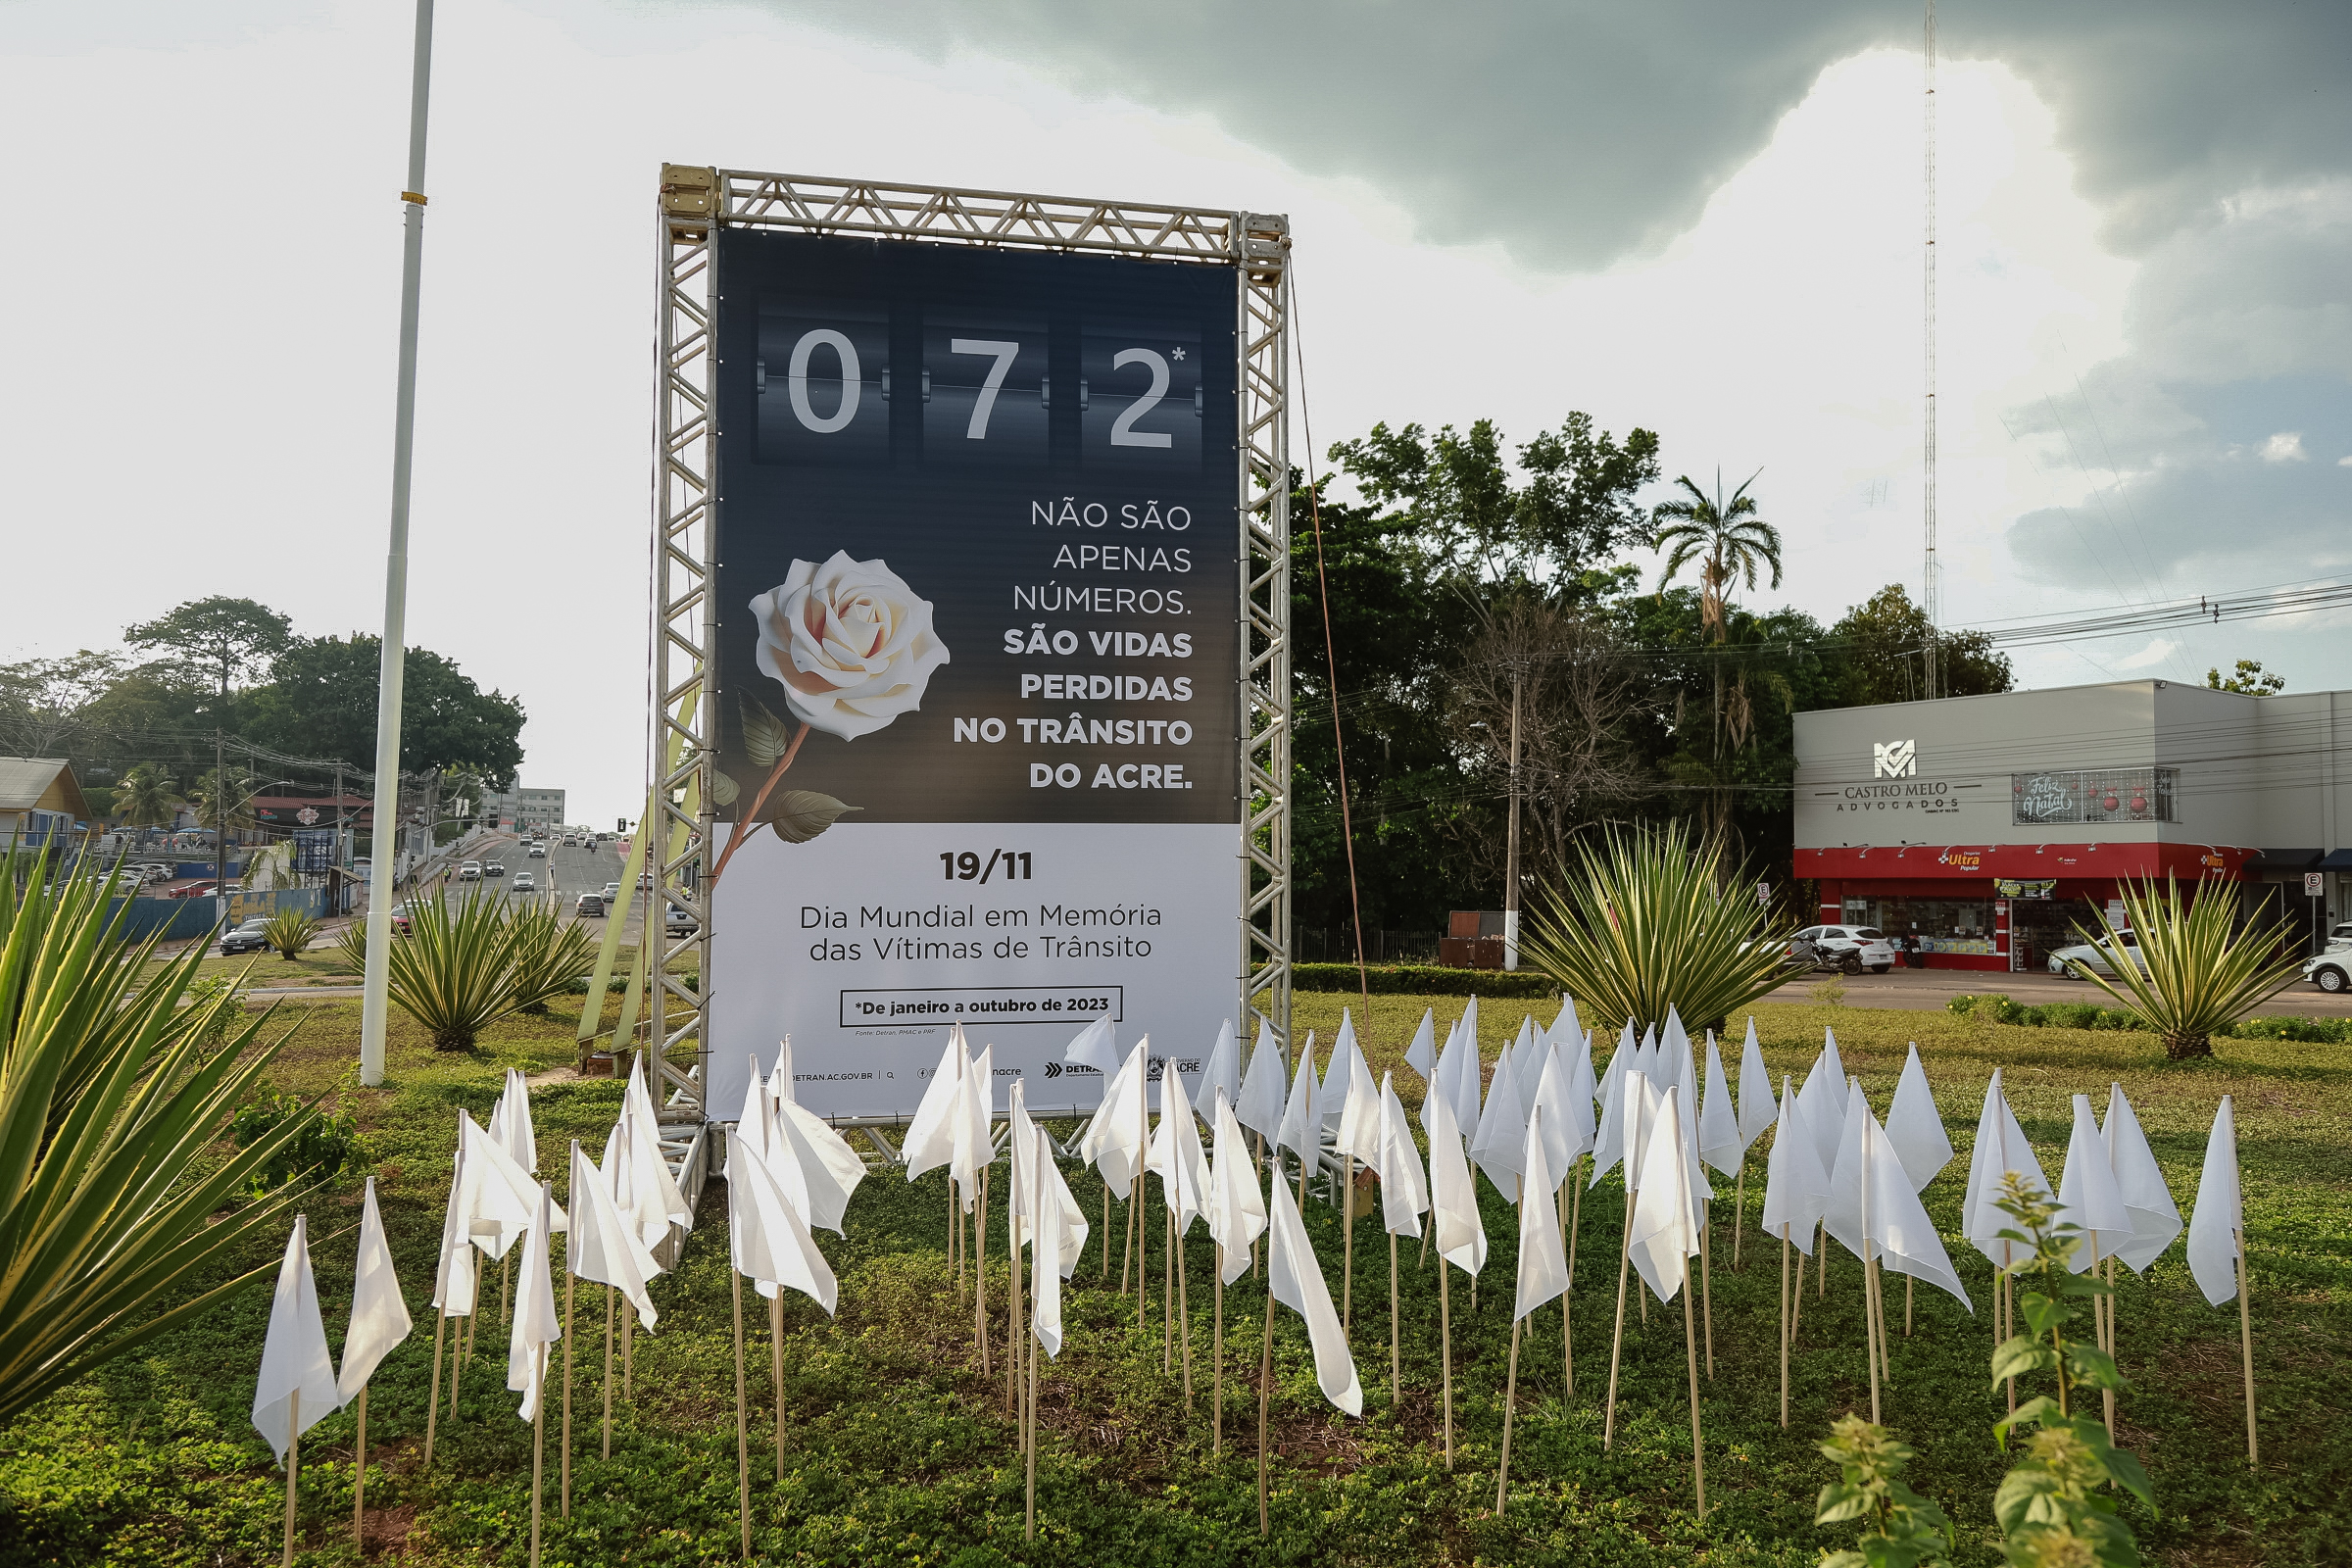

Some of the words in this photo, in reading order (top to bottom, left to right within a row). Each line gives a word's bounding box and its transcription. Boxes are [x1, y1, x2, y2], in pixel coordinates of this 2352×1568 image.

[788, 328, 861, 434] 0
[951, 338, 1019, 440] 7
[1033, 497, 1107, 527] NÃO
[1121, 501, 1191, 530] SÃO
[1054, 545, 1191, 572] APENAS
[1015, 580, 1191, 613] NÚMEROS.
[1004, 623, 1078, 655] SÃO
[1089, 631, 1192, 658] VIDAS
[1022, 674, 1193, 701] PERDIDAS
[955, 718, 1005, 742] NO
[1017, 712, 1192, 745] TRÂNSITO
[1031, 763, 1081, 788] DO
[1092, 764, 1192, 788] ACRE.
[2029, 776, 2062, 794] Feliz
[1844, 784, 1901, 799] CASTRO
[1905, 782, 1948, 796] MELO
[2023, 788, 2072, 817] Natal
[1837, 799, 1958, 811] ADVOGADOS
[940, 849, 1031, 884] 19/11
[1949, 854, 1980, 866] Ultra
[2207, 855, 2223, 867] Ultra
[802, 906, 847, 928] Dia
[861, 905, 972, 927] Mundial
[986, 910, 1027, 926] em
[1041, 904, 1160, 926] Memória
[810, 938, 860, 960] das
[873, 937, 982, 959] Vítimas
[994, 936, 1028, 958] de
[1040, 936, 1151, 957] Trânsito
[890, 1001, 950, 1016] janeiro
[955, 1004, 963, 1012] a
[969, 1000, 1036, 1012] outubro
[1042, 999, 1061, 1010] de
[1067, 999, 1108, 1010] 2023
